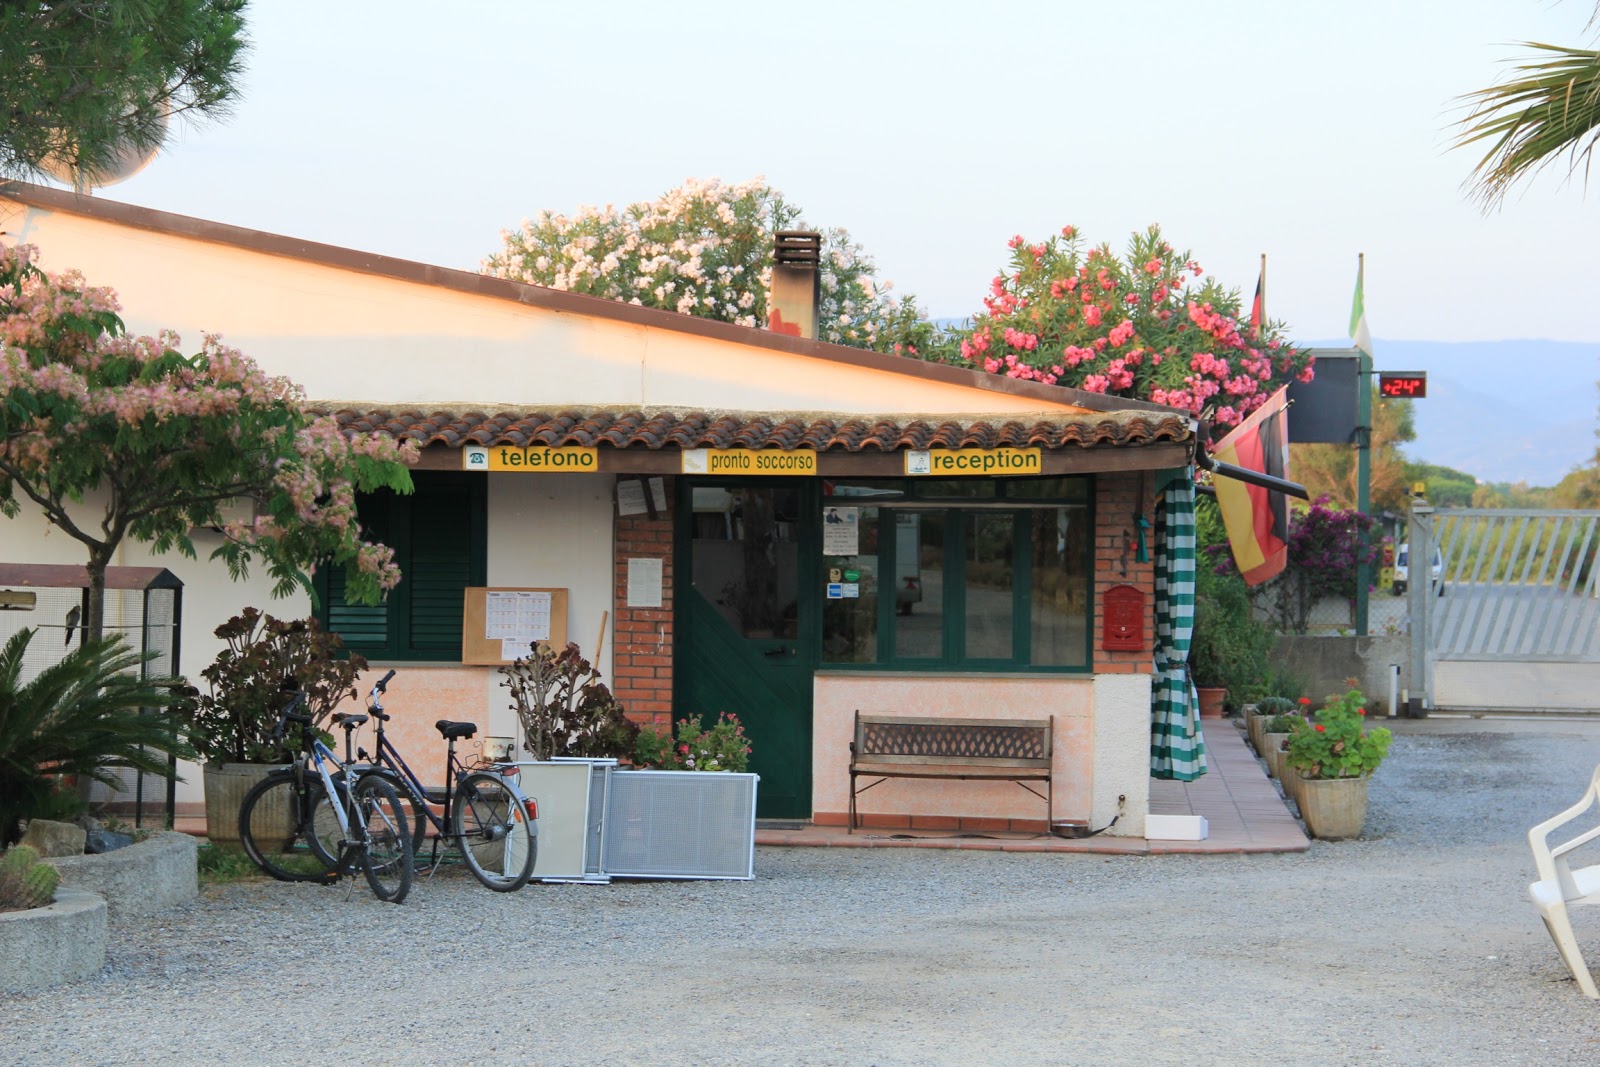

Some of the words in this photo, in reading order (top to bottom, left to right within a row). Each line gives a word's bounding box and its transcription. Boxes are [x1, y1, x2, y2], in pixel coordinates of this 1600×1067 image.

[500, 447, 594, 466] telefono
[711, 452, 750, 471] pronto
[756, 455, 813, 469] soccorso
[934, 450, 1037, 472] reception
